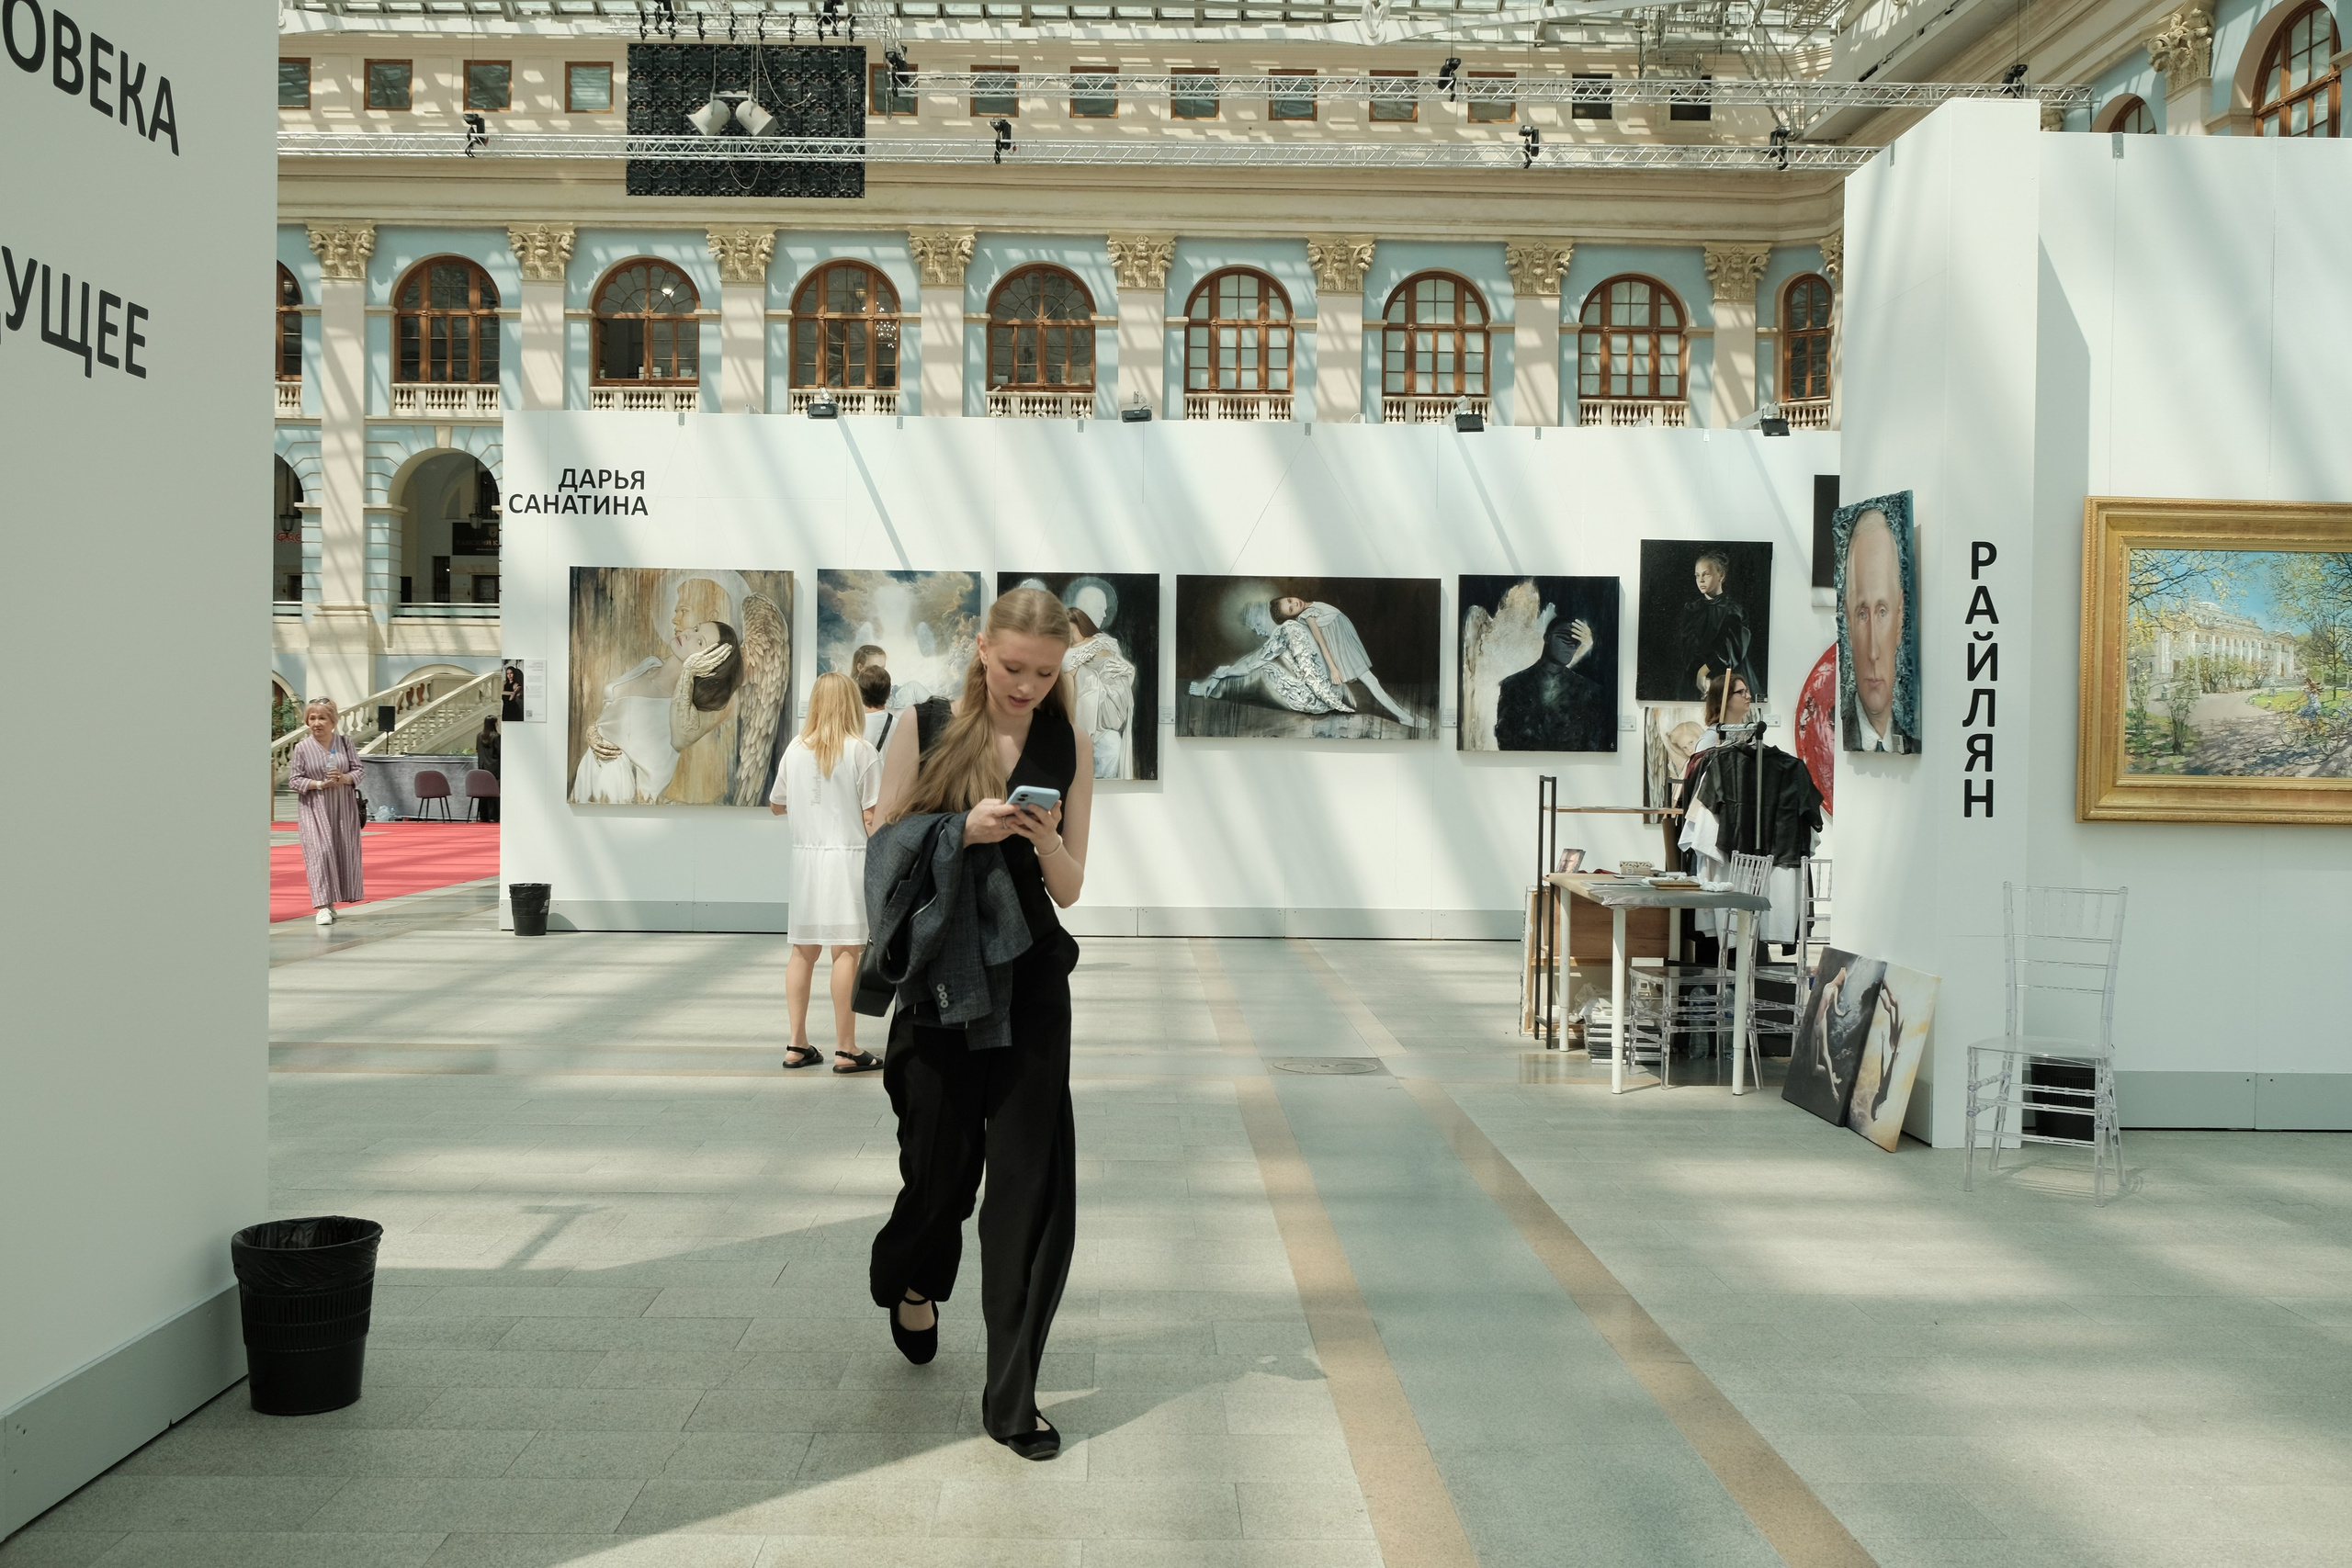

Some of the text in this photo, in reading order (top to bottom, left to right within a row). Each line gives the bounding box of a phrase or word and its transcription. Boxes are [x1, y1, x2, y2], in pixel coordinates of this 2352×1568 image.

[0, 246, 148, 378] УЩЕЕ
[509, 494, 648, 515] САНАТИНА
[559, 468, 644, 492] ДАРЬЯ
[1962, 542, 1999, 818] РАЙЛЯН
